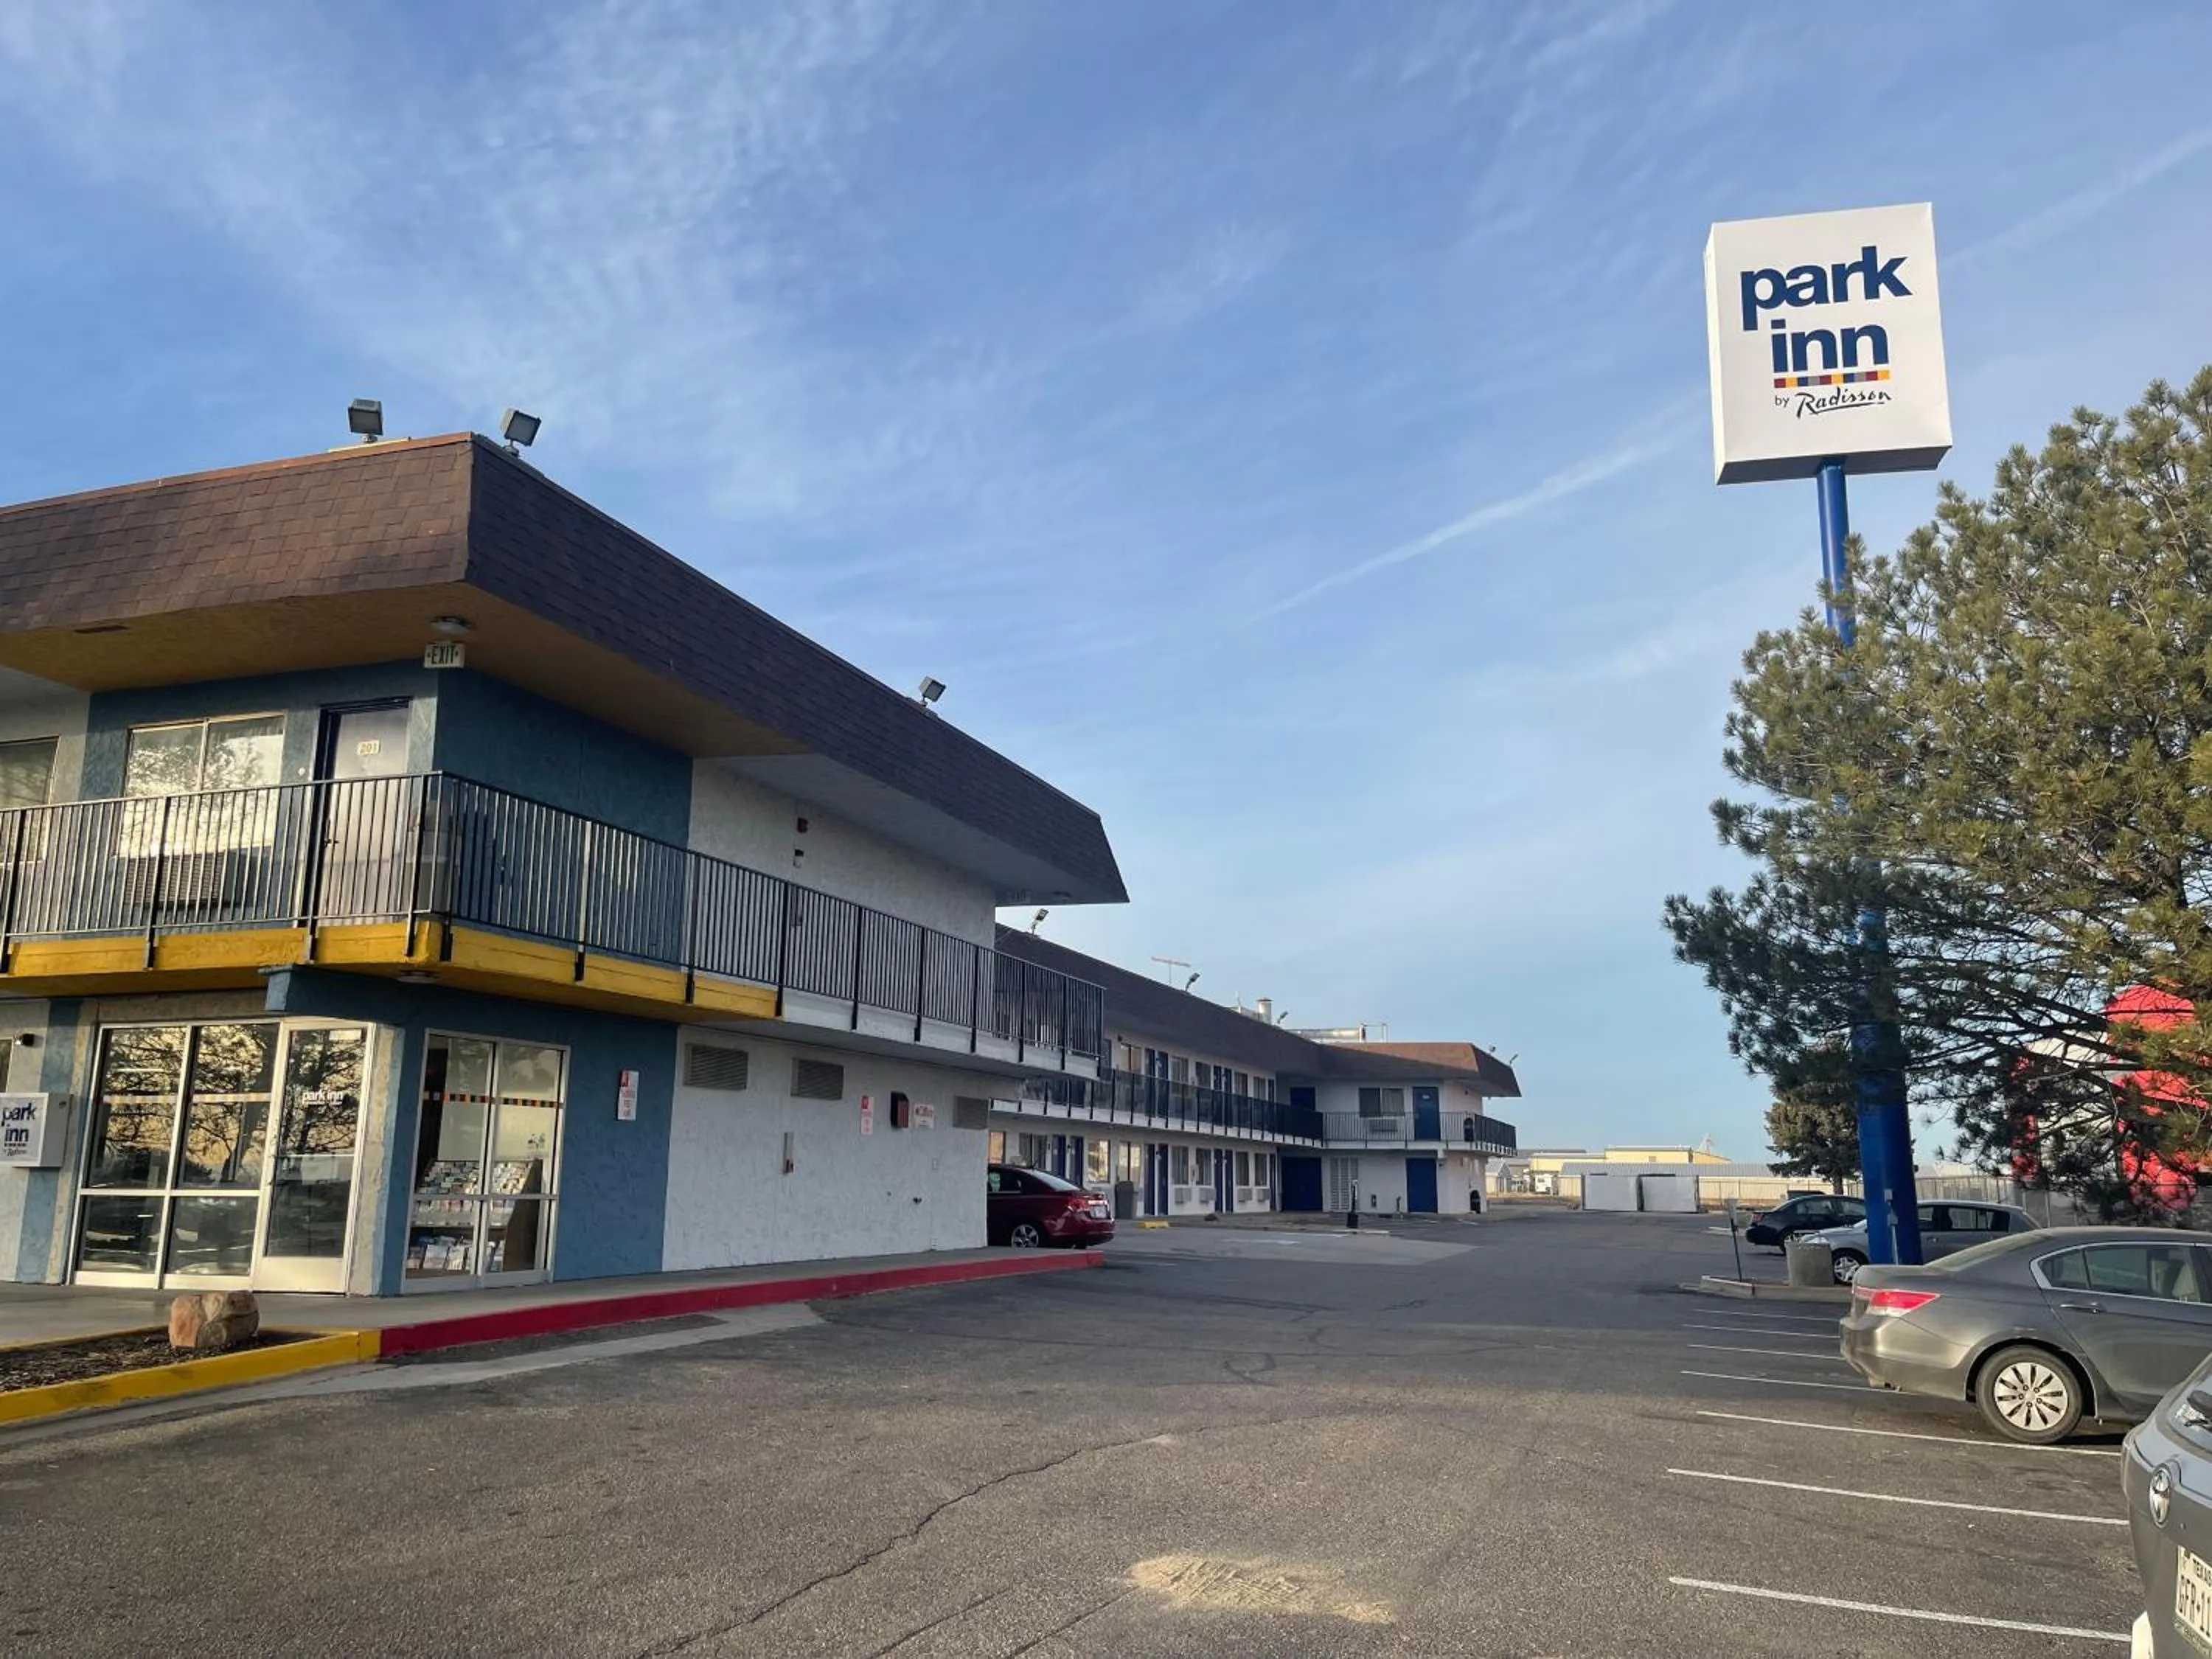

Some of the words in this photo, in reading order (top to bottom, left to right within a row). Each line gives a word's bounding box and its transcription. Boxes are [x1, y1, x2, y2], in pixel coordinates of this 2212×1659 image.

[1740, 246, 1913, 331] park
[1770, 319, 1889, 373] inn
[1775, 396, 1790, 407] by
[1795, 386, 1892, 419] Radisson
[431, 645, 456, 664] EXIT
[302, 1088, 325, 1105] park
[327, 1090, 343, 1101] inn
[1, 1102, 37, 1127] park
[5, 1123, 29, 1142] inn
